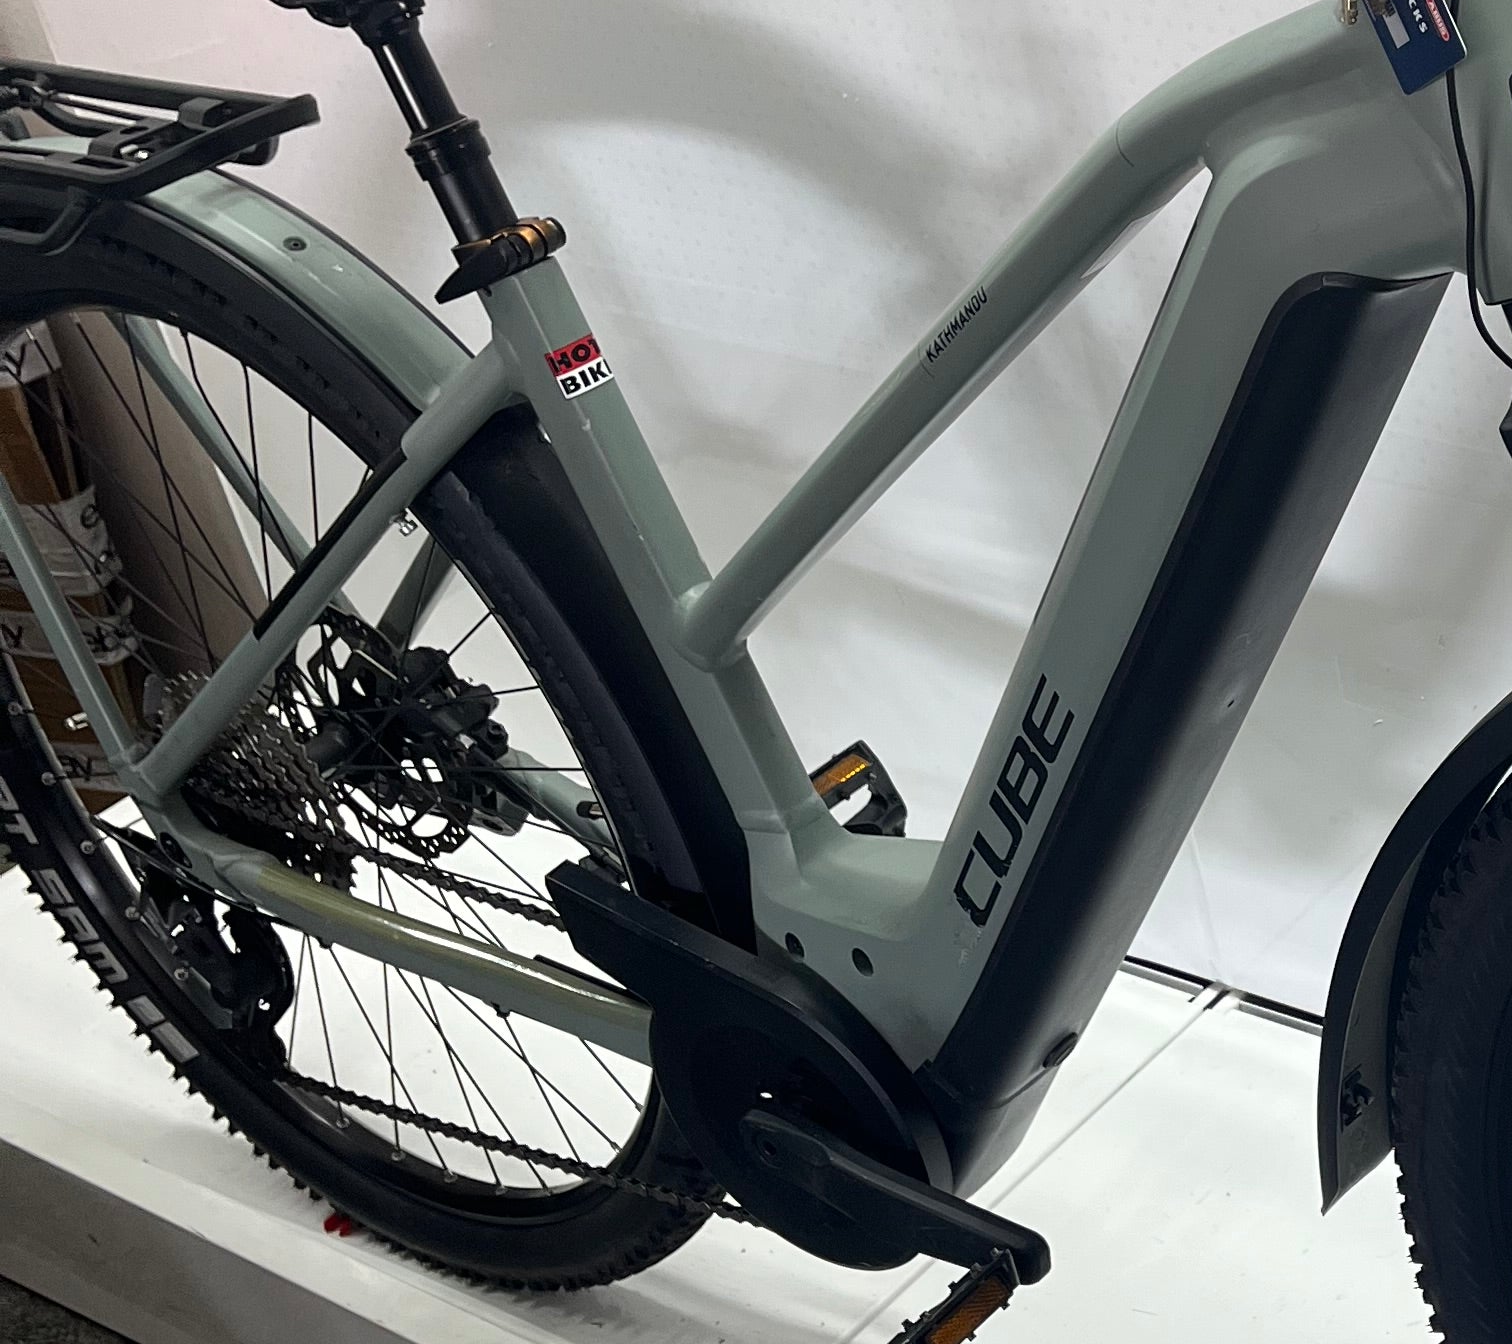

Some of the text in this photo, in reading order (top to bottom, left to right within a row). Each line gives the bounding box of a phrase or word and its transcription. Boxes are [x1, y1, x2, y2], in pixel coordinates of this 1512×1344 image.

[546, 340, 602, 373] HOT
[925, 285, 989, 363] KATHMANDU
[953, 672, 1075, 928] CUBE
[32, 868, 129, 985] SAM
